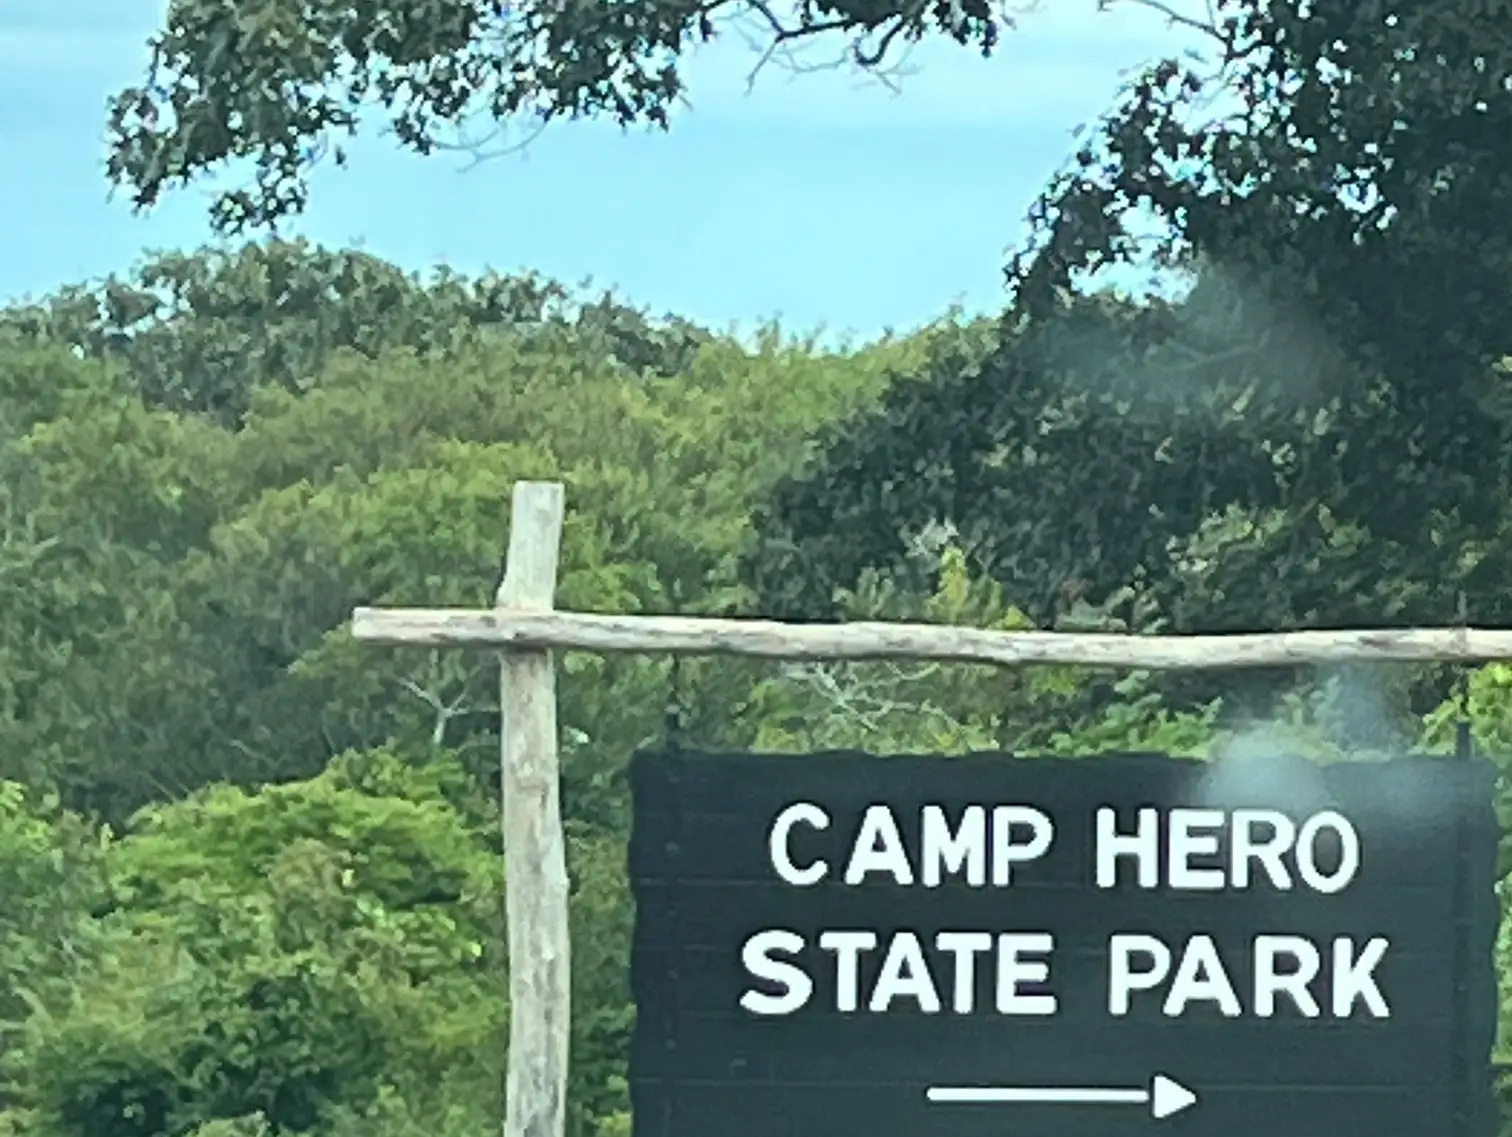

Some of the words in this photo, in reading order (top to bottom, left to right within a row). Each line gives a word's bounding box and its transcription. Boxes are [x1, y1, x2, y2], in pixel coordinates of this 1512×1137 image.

[770, 803, 1053, 888] CAMP
[1096, 808, 1360, 895] HERO
[739, 930, 1057, 1016] STATE
[1108, 934, 1391, 1018] PARK
